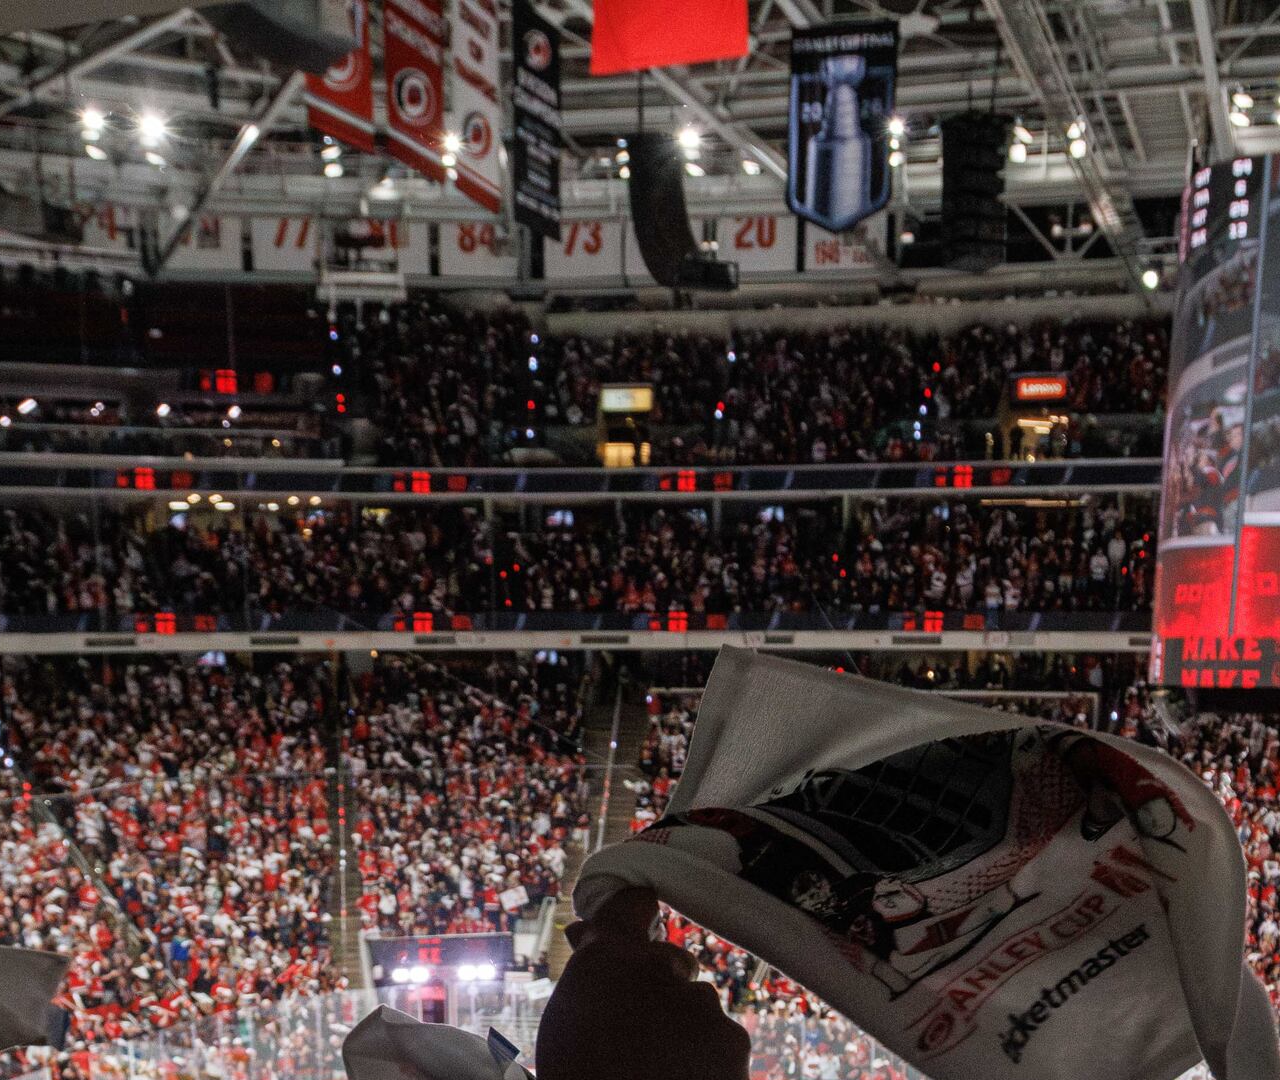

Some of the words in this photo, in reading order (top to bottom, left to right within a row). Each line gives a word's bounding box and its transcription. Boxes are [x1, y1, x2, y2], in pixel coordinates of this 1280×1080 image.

[564, 219, 603, 257] 73
[734, 216, 777, 250] 20
[1050, 894, 1106, 939] CUP
